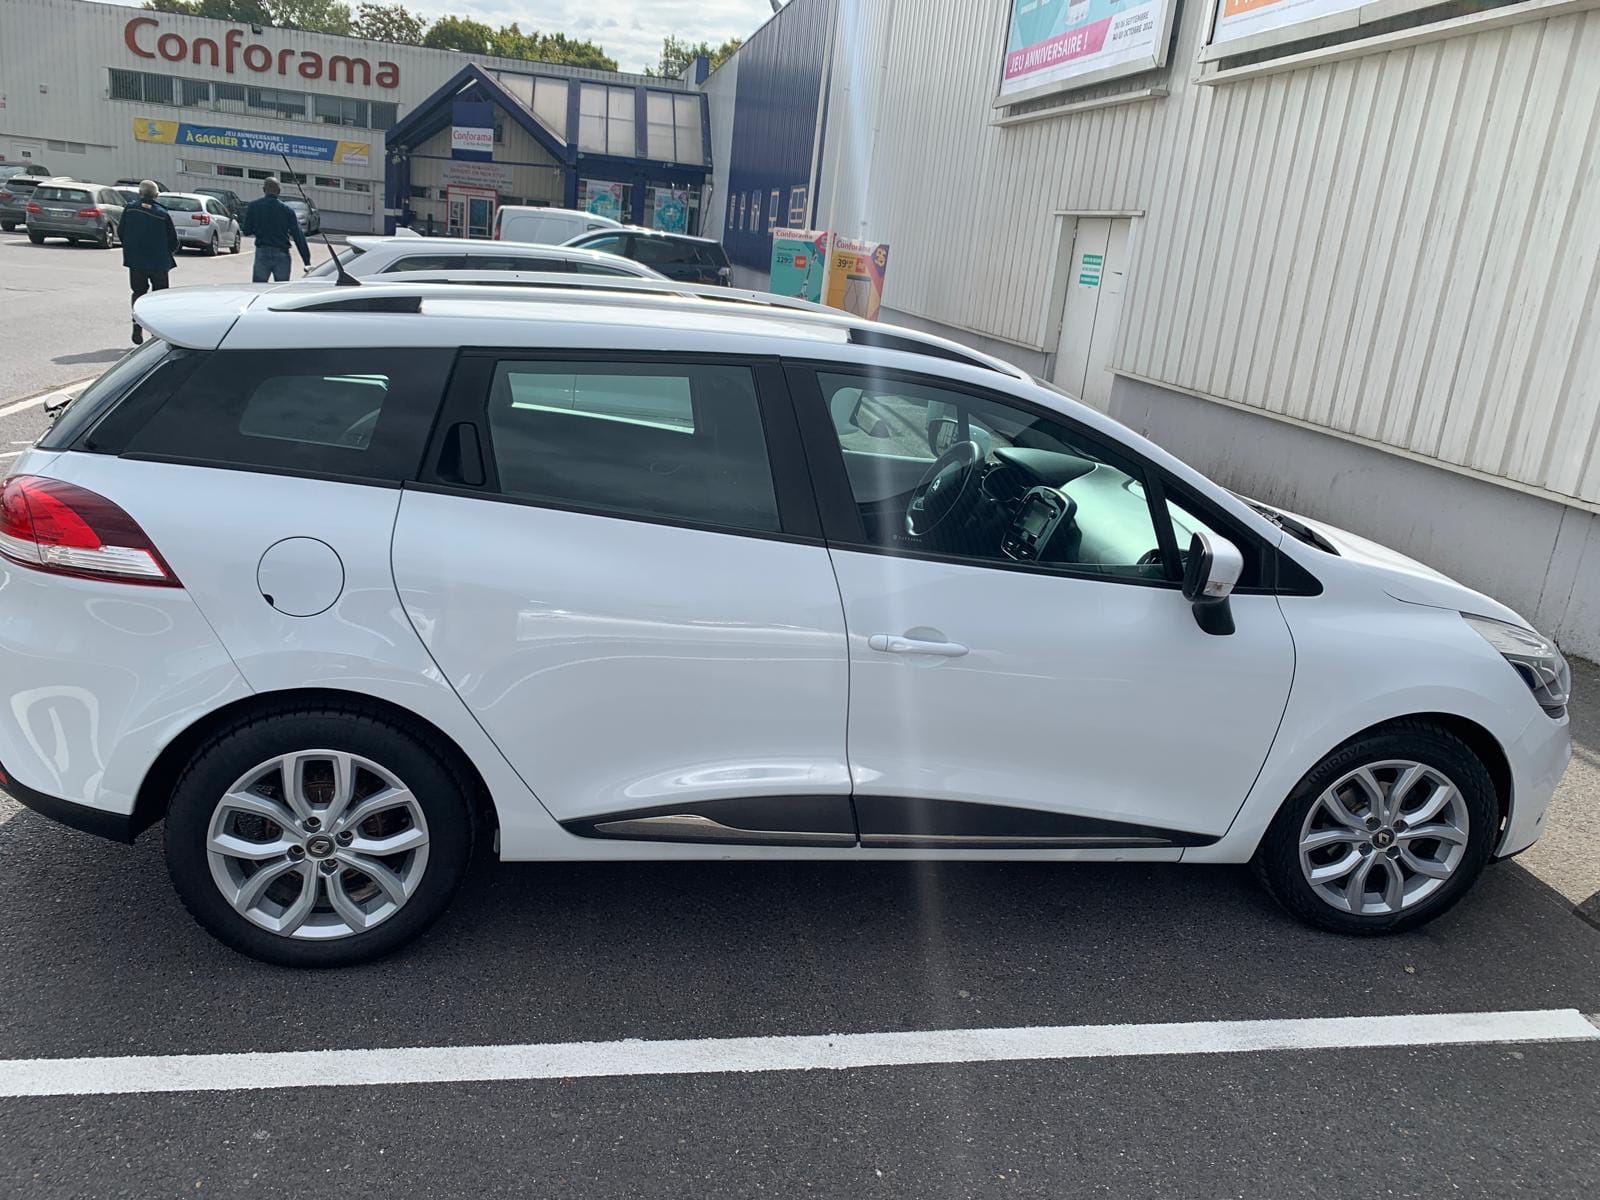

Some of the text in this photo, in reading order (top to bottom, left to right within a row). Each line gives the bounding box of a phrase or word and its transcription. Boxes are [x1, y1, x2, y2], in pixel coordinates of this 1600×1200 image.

[124, 17, 400, 89] Conforama
[1009, 55, 1024, 73] JEU
[1024, 36, 1083, 67] ANNIVERSAIRE
[186, 129, 290, 153] À GAGNER 1 VOYAGE
[237, 132, 280, 142] ANNIVERSAIRE
[453, 130, 492, 142] Conforama
[776, 231, 813, 240] Conforama
[1308, 742, 1370, 783] UNIROYA
